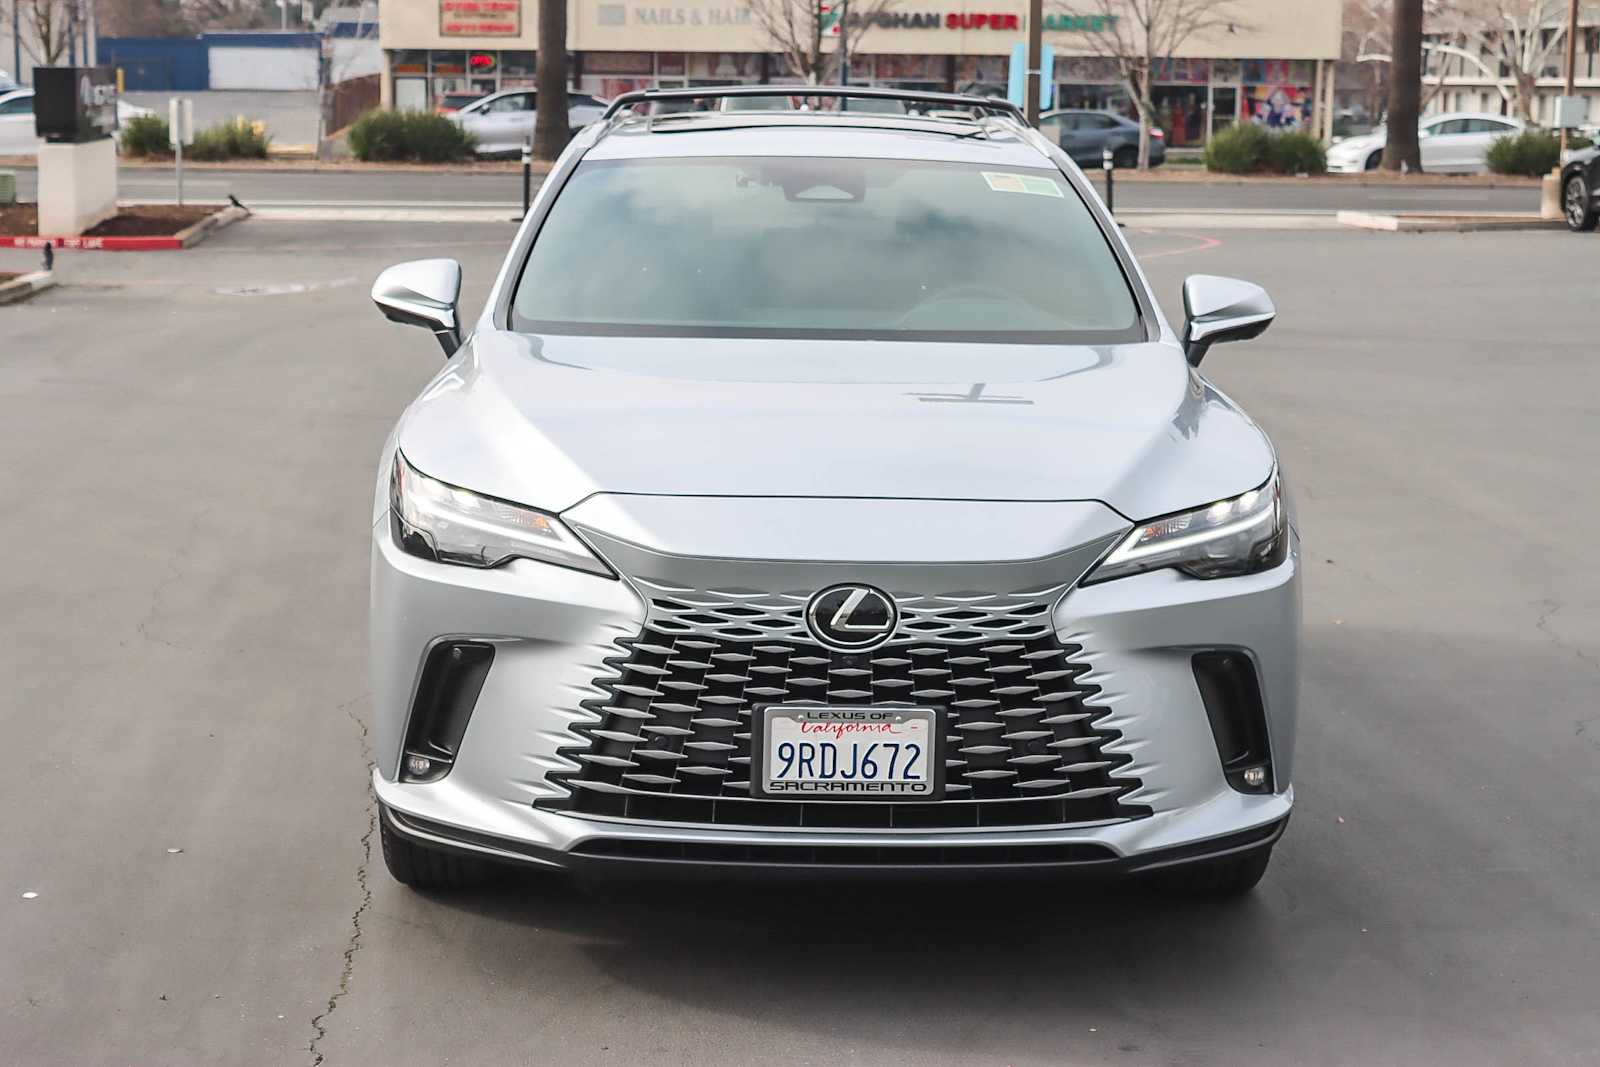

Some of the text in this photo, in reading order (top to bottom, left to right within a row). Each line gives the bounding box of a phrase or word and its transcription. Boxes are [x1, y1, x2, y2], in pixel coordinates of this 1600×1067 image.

[634, 8, 685, 25] NAILS
[690, 8, 703, 25] &
[945, 13, 1019, 31] SUPER
[1023, 15, 1119, 33] ARKET
[806, 711, 893, 720] LEXUS OF
[801, 721, 902, 739] California
[776, 743, 921, 780] 9RDJ672
[769, 781, 927, 792] SACRAMENTO
